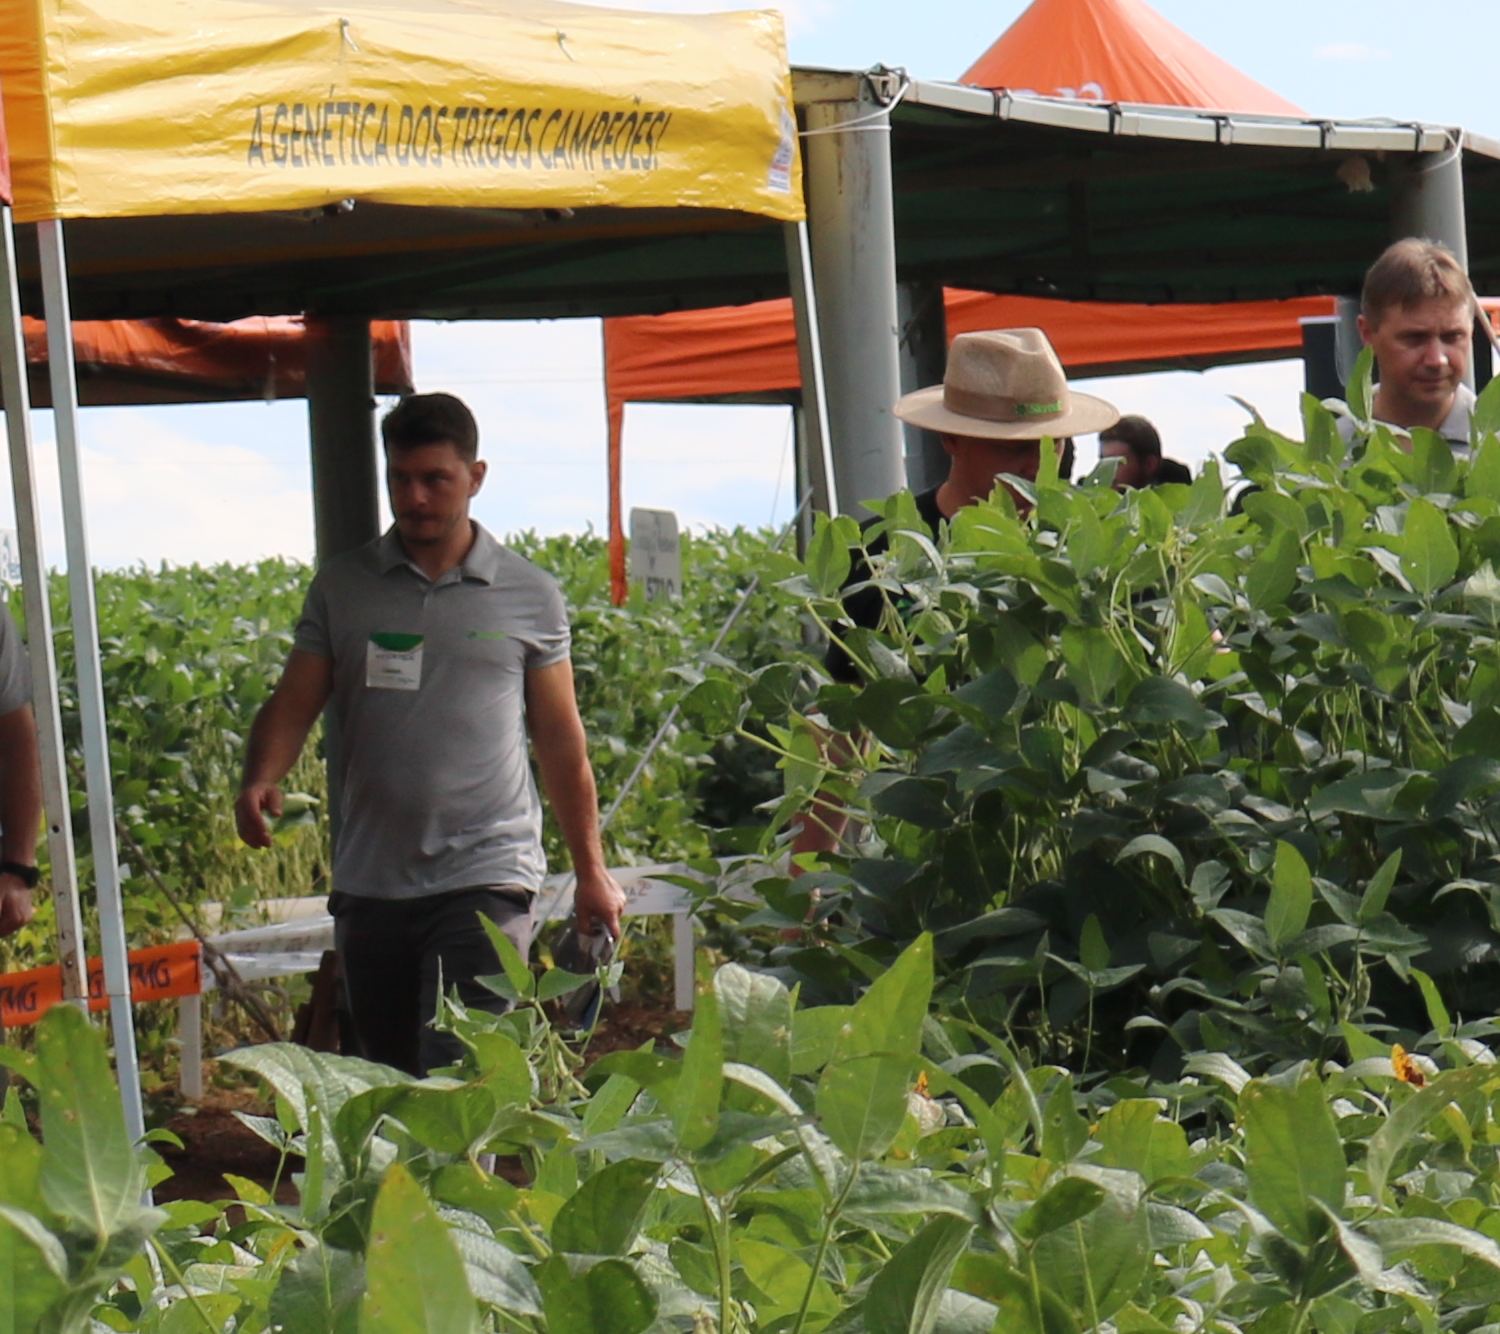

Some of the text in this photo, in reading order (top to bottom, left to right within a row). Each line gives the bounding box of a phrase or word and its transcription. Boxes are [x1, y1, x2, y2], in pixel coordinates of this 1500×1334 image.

[247, 103, 266, 167] A
[270, 84, 390, 167] GENÉTICA
[396, 103, 448, 167] DOS
[450, 107, 542, 169] TRIGOS
